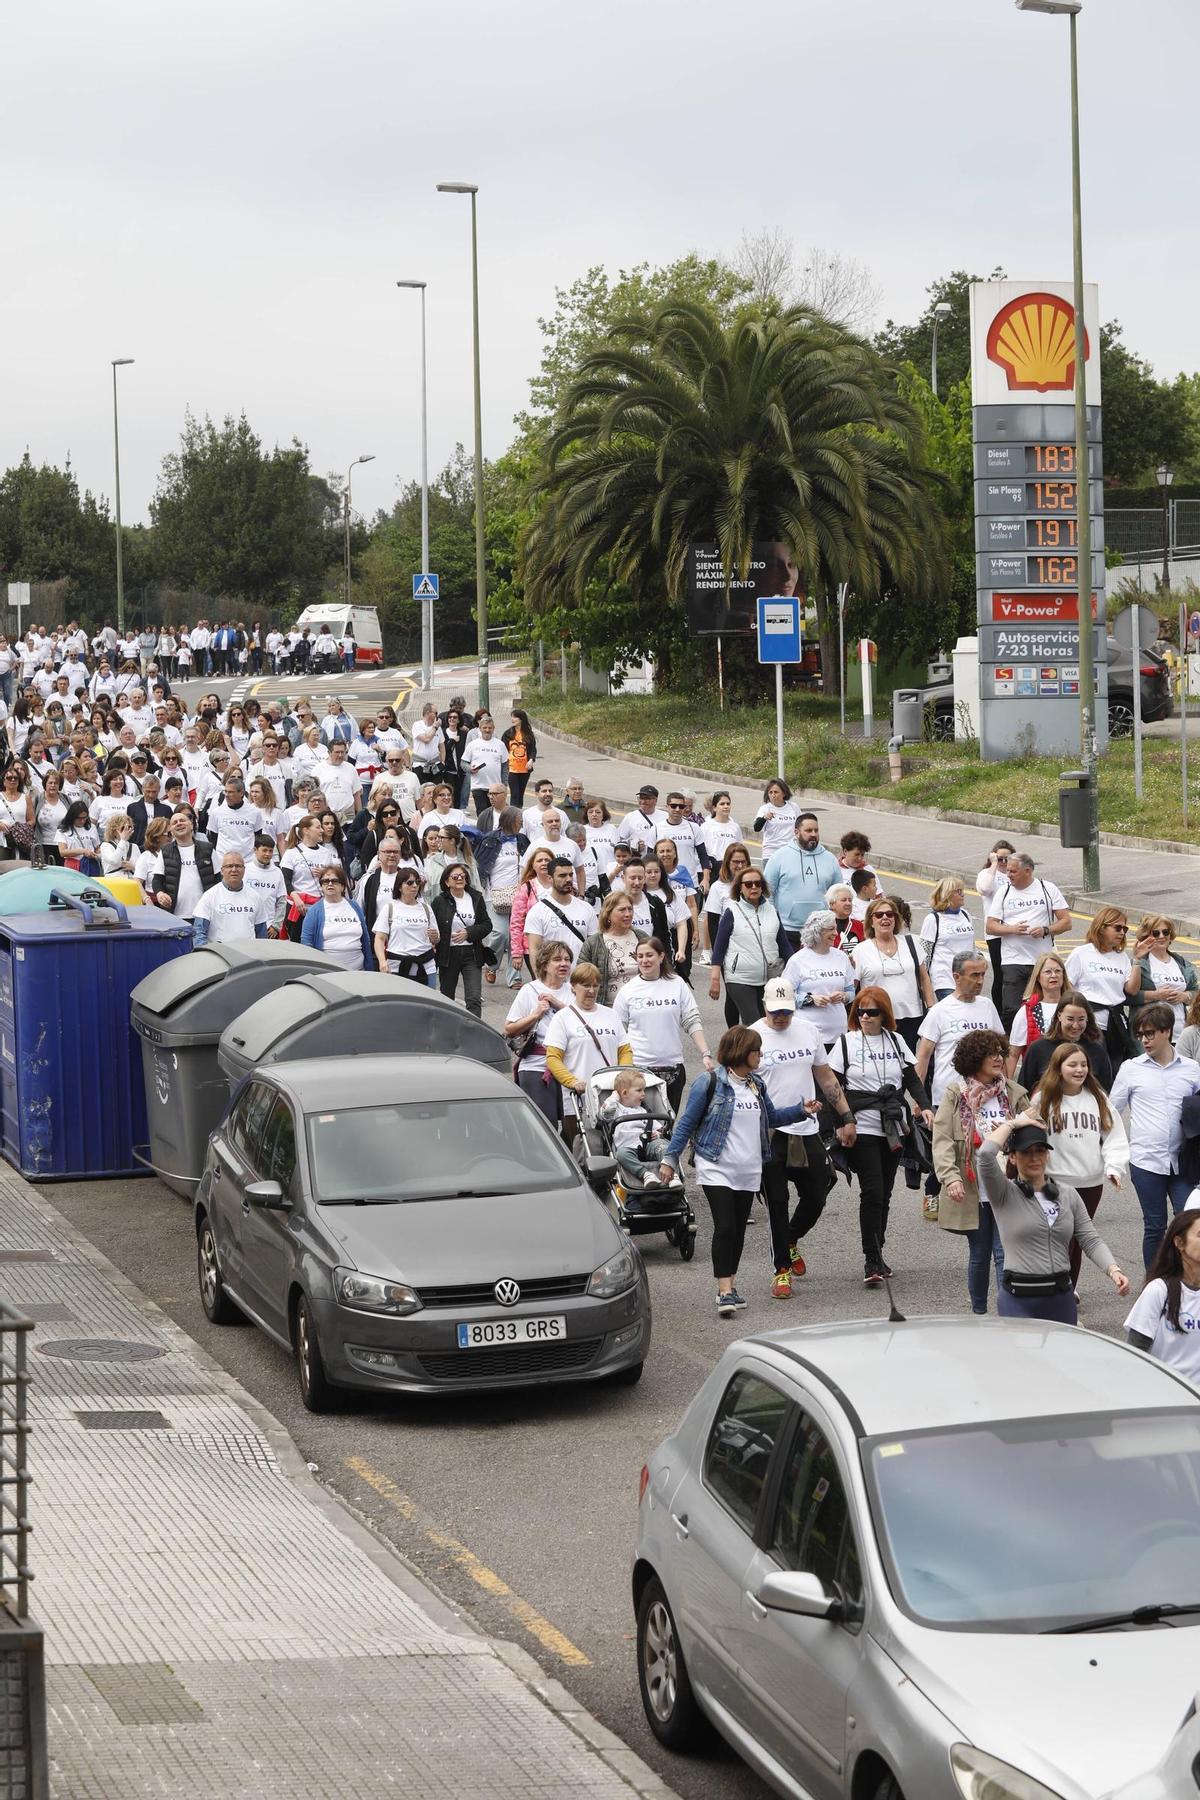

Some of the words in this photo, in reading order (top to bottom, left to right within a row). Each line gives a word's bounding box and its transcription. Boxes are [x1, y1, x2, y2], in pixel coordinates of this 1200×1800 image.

[988, 450, 1008, 458] Diesel
[1034, 446, 1078, 472] 1.83
[988, 486, 999, 494] Sin
[1001, 486, 1022, 494] Plomo
[1034, 483, 1078, 509] 1.52
[990, 523, 1021, 531] V-Power
[1036, 520, 1079, 546] 1.91
[1001, 604, 1060, 616] V-Power
[998, 632, 1080, 643] Autoservicio
[998, 645, 1028, 656] 7-23
[1033, 645, 1073, 656] Horas
[472, 1323, 516, 1343] 8033
[526, 1320, 560, 1338] GRS
